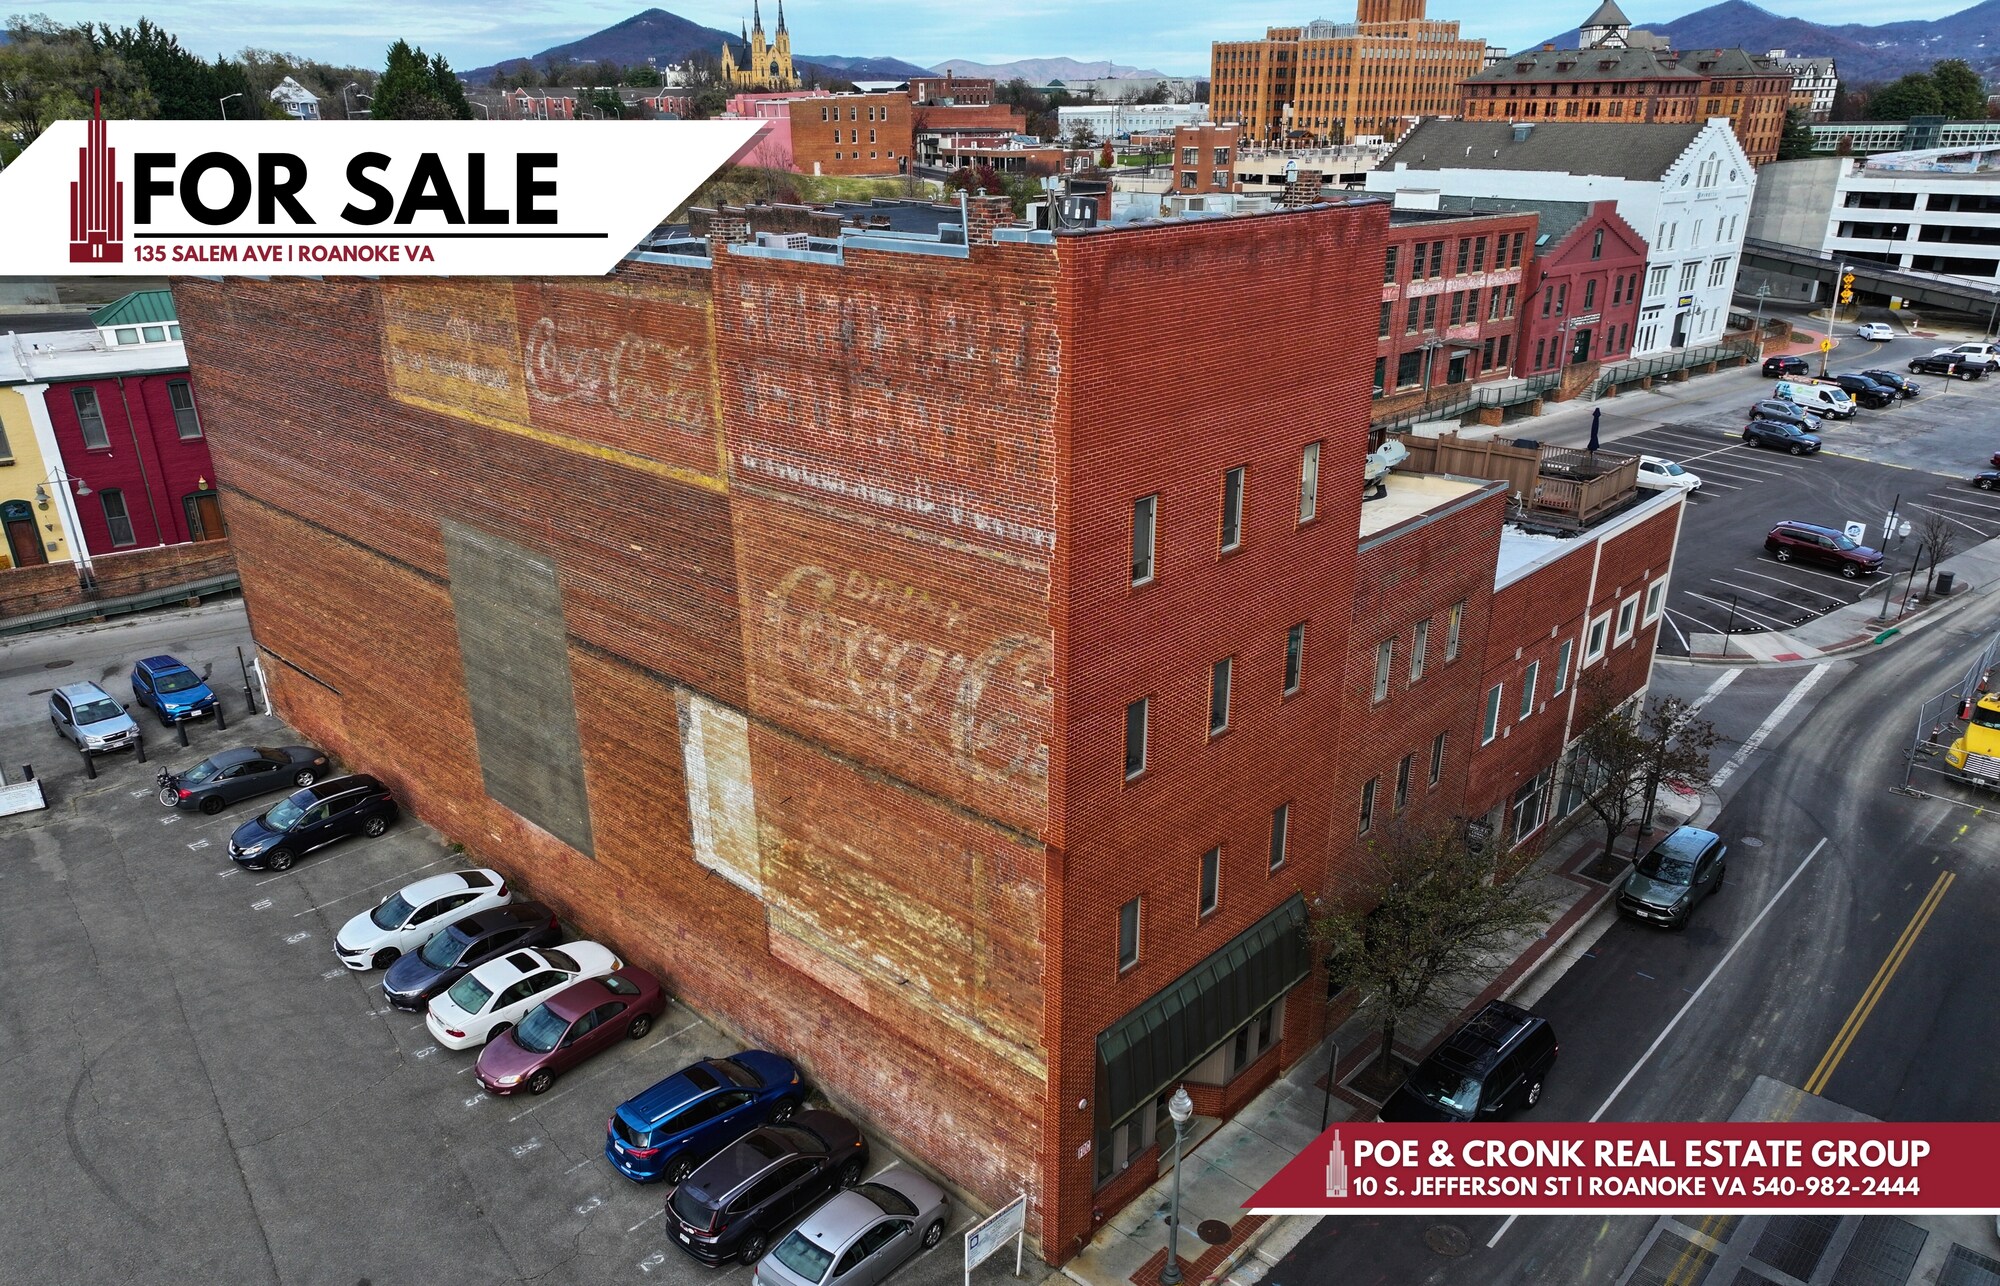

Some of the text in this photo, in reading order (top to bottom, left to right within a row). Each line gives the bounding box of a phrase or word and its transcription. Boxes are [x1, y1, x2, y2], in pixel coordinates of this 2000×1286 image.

[251, 899, 272, 911] 10
[415, 1046, 437, 1058] 6
[464, 1093, 489, 1107] 5
[640, 1254, 665, 1272] 2
